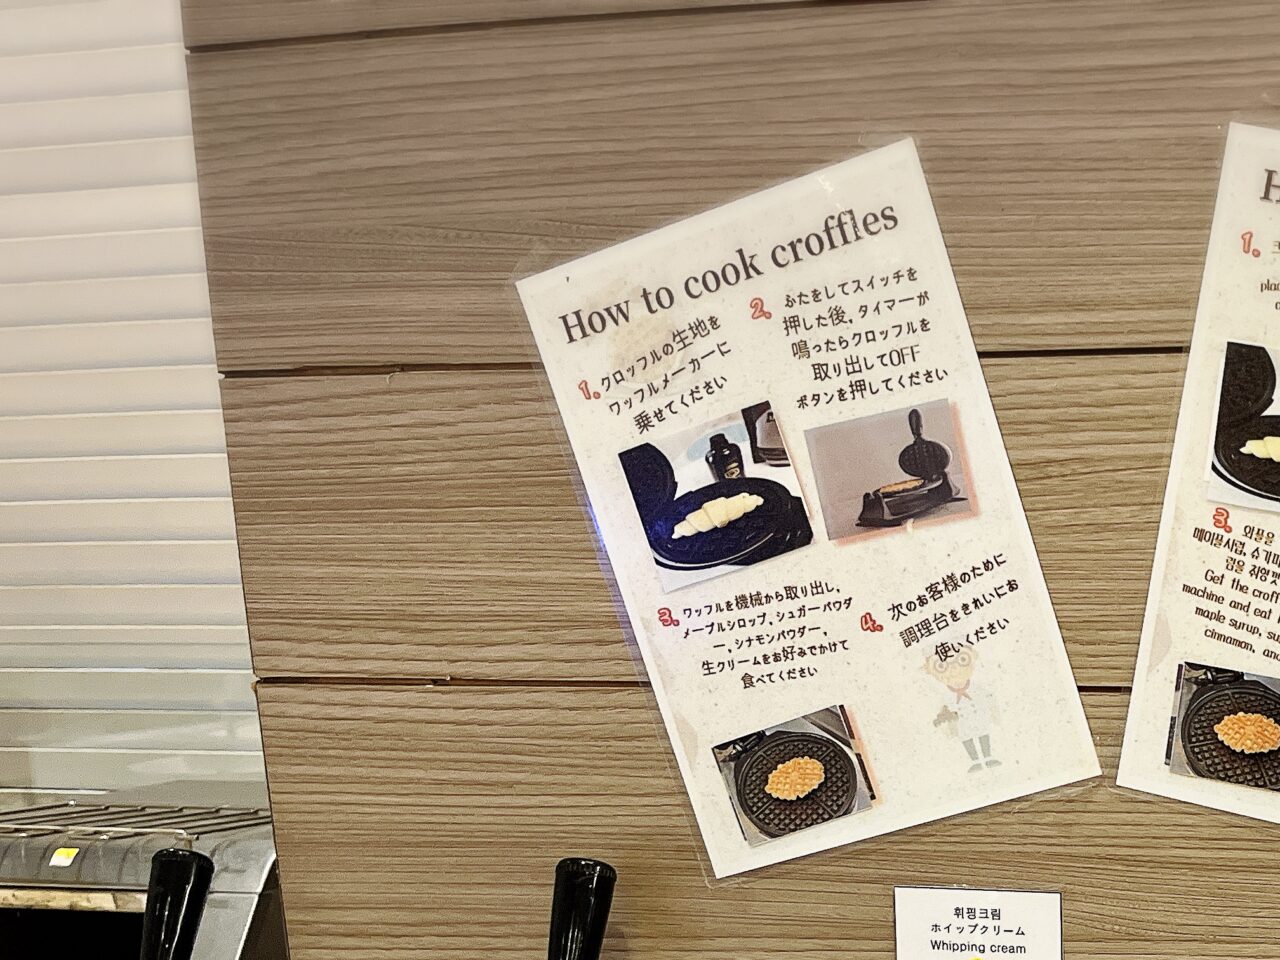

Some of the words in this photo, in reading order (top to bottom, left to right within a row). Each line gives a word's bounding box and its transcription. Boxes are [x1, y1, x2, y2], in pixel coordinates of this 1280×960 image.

[1241, 231, 1261, 257] 1.
[559, 300, 630, 343] How
[641, 287, 674, 314] to
[684, 248, 764, 299] cook
[771, 206, 898, 268] croffles
[785, 267, 917, 308] ふたをしてスイッチを
[750, 297, 772, 319] 2.
[601, 316, 720, 392] クロッフルの生地を
[792, 318, 930, 359] 鳴ったらクロッフルを
[609, 341, 731, 415] ワッフルメーカーに
[812, 344, 920, 381] 取り出してOFF
[578, 380, 601, 399] 1.
[633, 376, 727, 434] 乗せてください
[797, 368, 948, 409] ボタンを押してください
[1213, 507, 1232, 533] 3.
[888, 553, 1006, 621] 次のお客様のために
[1204, 569, 1224, 585] Get
[1231, 577, 1249, 593] the
[658, 608, 679, 627] 3.
[900, 579, 1019, 648] 調理台をきれいにお
[1182, 582, 1225, 605] machine
[1229, 599, 1250, 613] and
[1254, 607, 1272, 620] eat
[1195, 606, 1226, 625] maple
[861, 612, 883, 632] 4.
[935, 618, 1010, 662] 使いください
[702, 640, 849, 676] 生クリームをお好みでかけて
[741, 666, 818, 689] 食べてください
[931, 923, 1025, 935] ホイップクリーム
[954, 907, 1000, 920] 휘핑크림
[930, 940, 985, 953] Whipping
[990, 945, 1026, 953] cream
